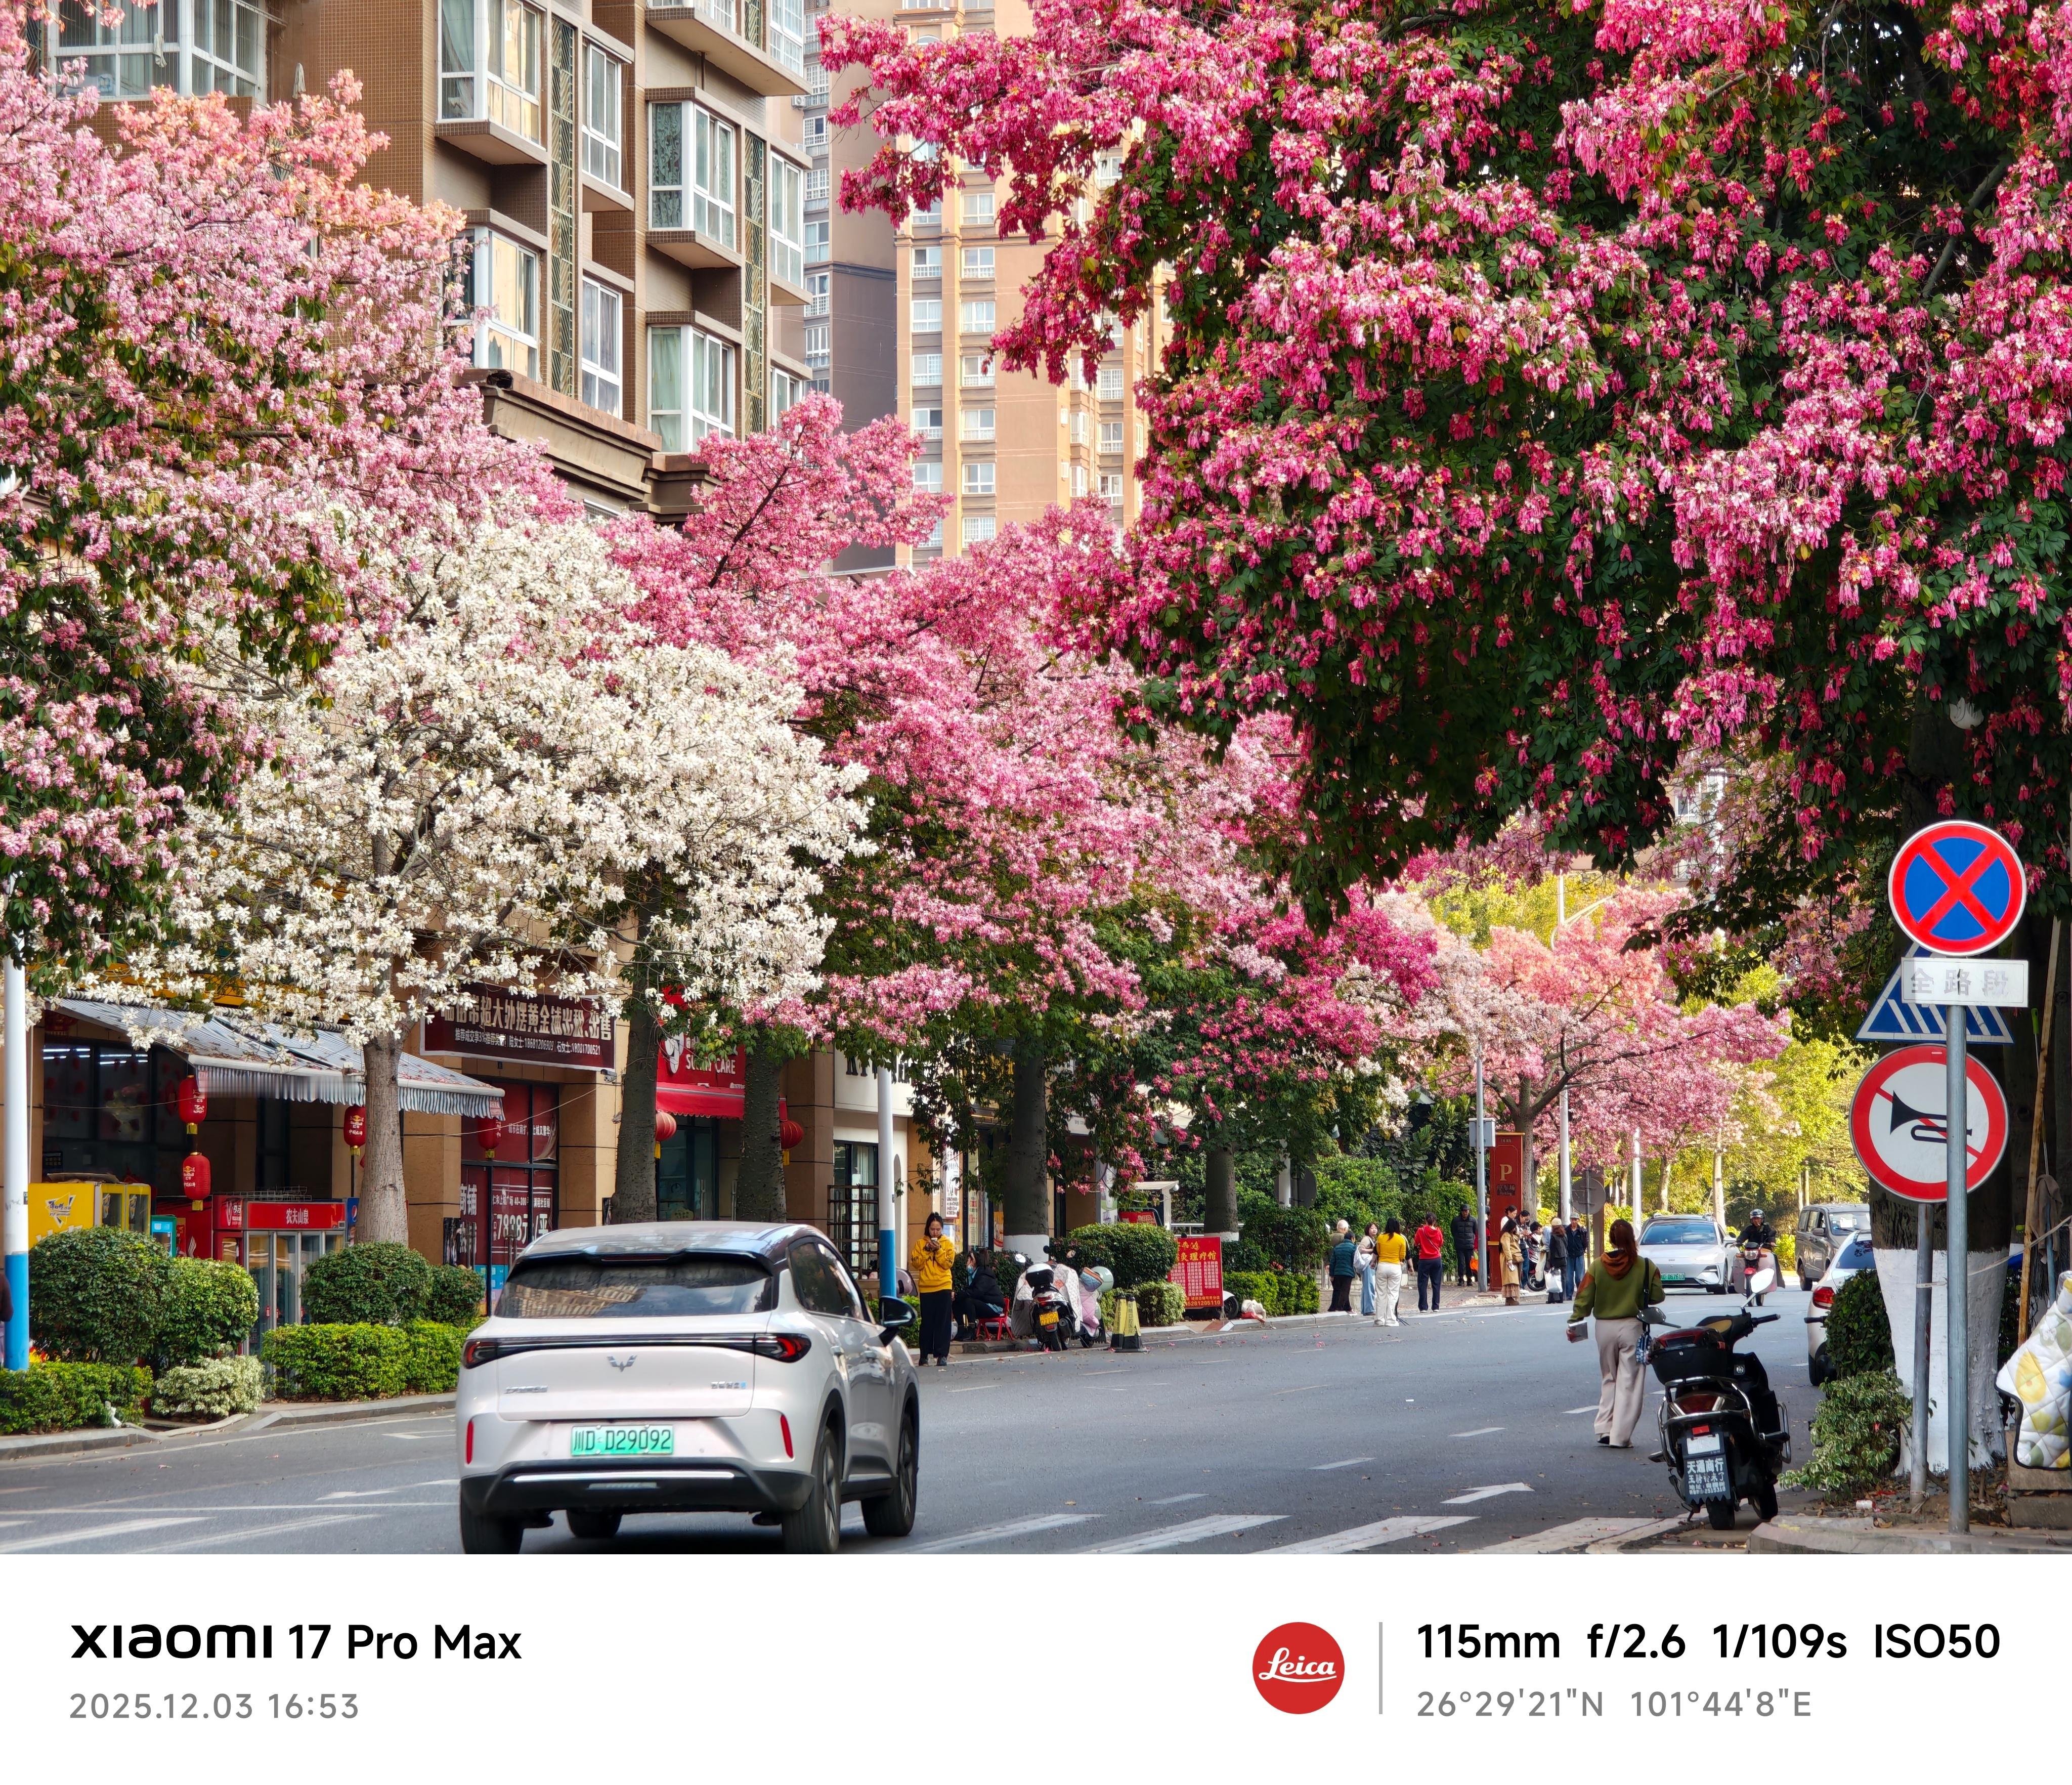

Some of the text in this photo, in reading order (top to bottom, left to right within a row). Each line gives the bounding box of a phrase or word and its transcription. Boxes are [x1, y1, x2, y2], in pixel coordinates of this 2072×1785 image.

[1911, 968, 2009, 996] 全路段
[1499, 1164, 1513, 1181] P
[286, 1208, 309, 1225] 农夫山泉
[573, 1429, 671, 1451] 川D D29092
[1687, 1458, 1724, 1474] 天通商行
